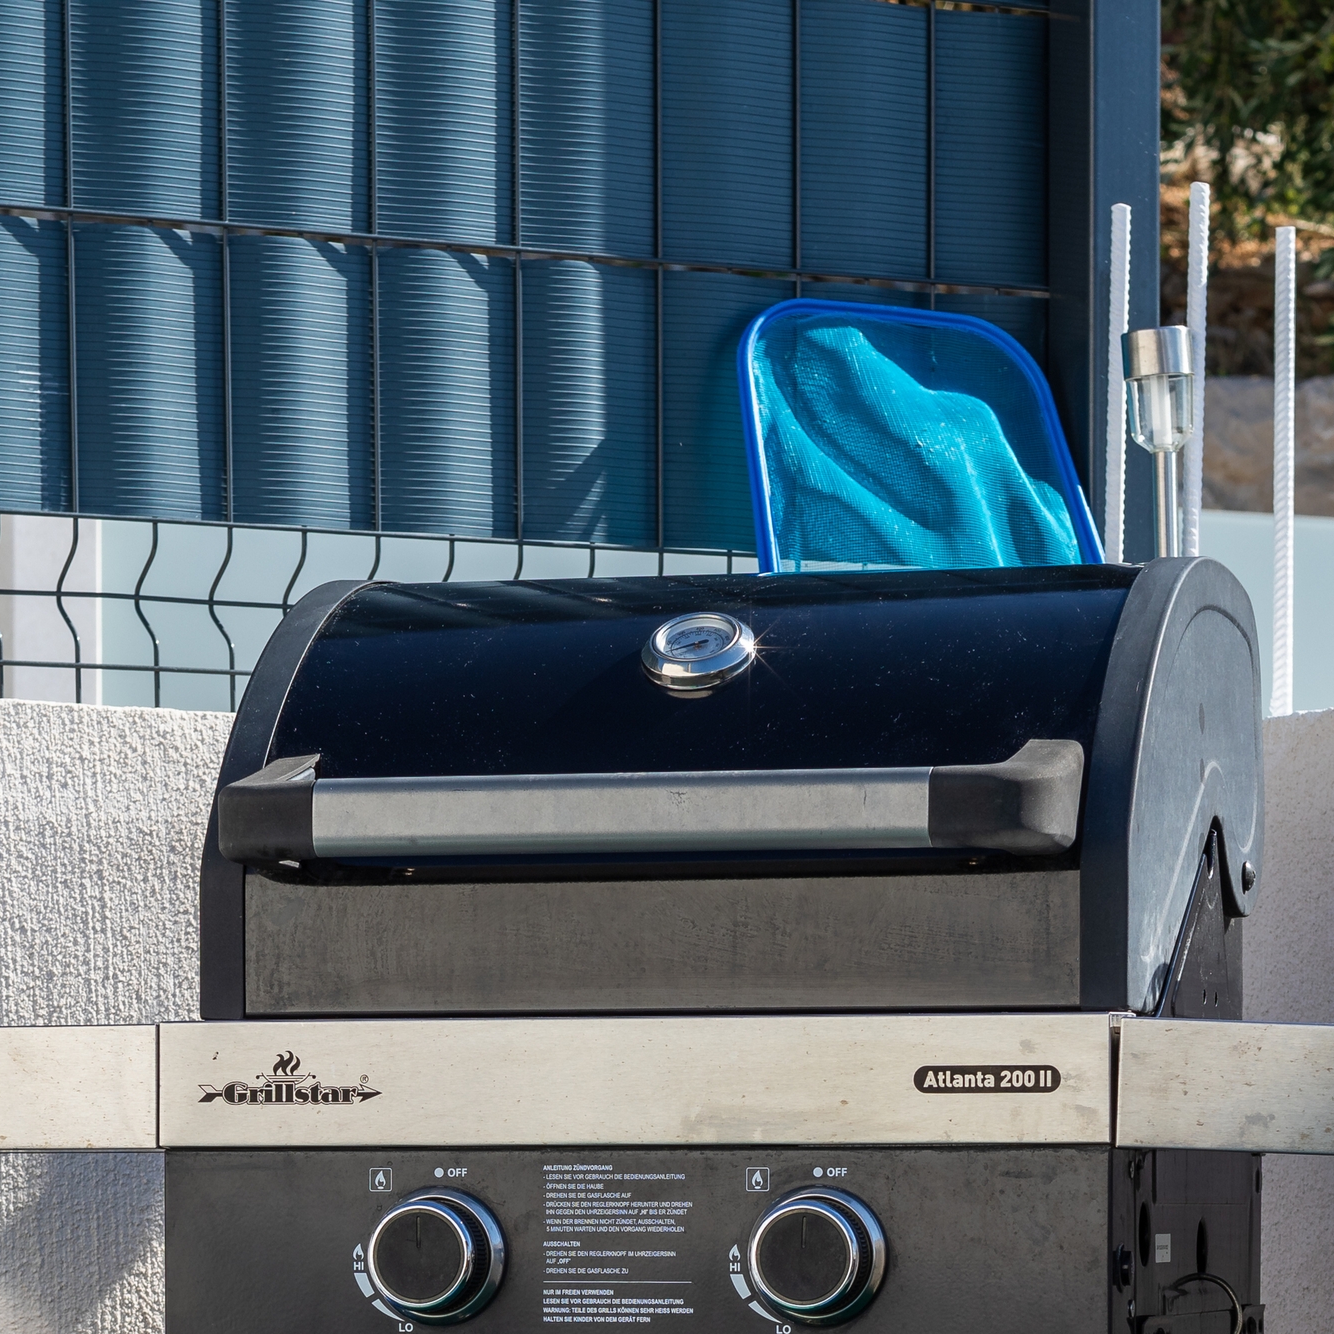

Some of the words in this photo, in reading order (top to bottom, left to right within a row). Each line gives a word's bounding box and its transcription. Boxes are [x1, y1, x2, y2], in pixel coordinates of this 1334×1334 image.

[923, 1070, 995, 1088] Atlanta
[1000, 1070, 1035, 1088] 200
[1039, 1070, 1052, 1088] II
[222, 1081, 358, 1104] Grillstar
[447, 1168, 467, 1177] OFF
[827, 1167, 847, 1177] OFF
[353, 1261, 364, 1270] HI
[730, 1263, 740, 1272] HI
[398, 1323, 413, 1332] LO
[776, 1325, 791, 1334] LO
